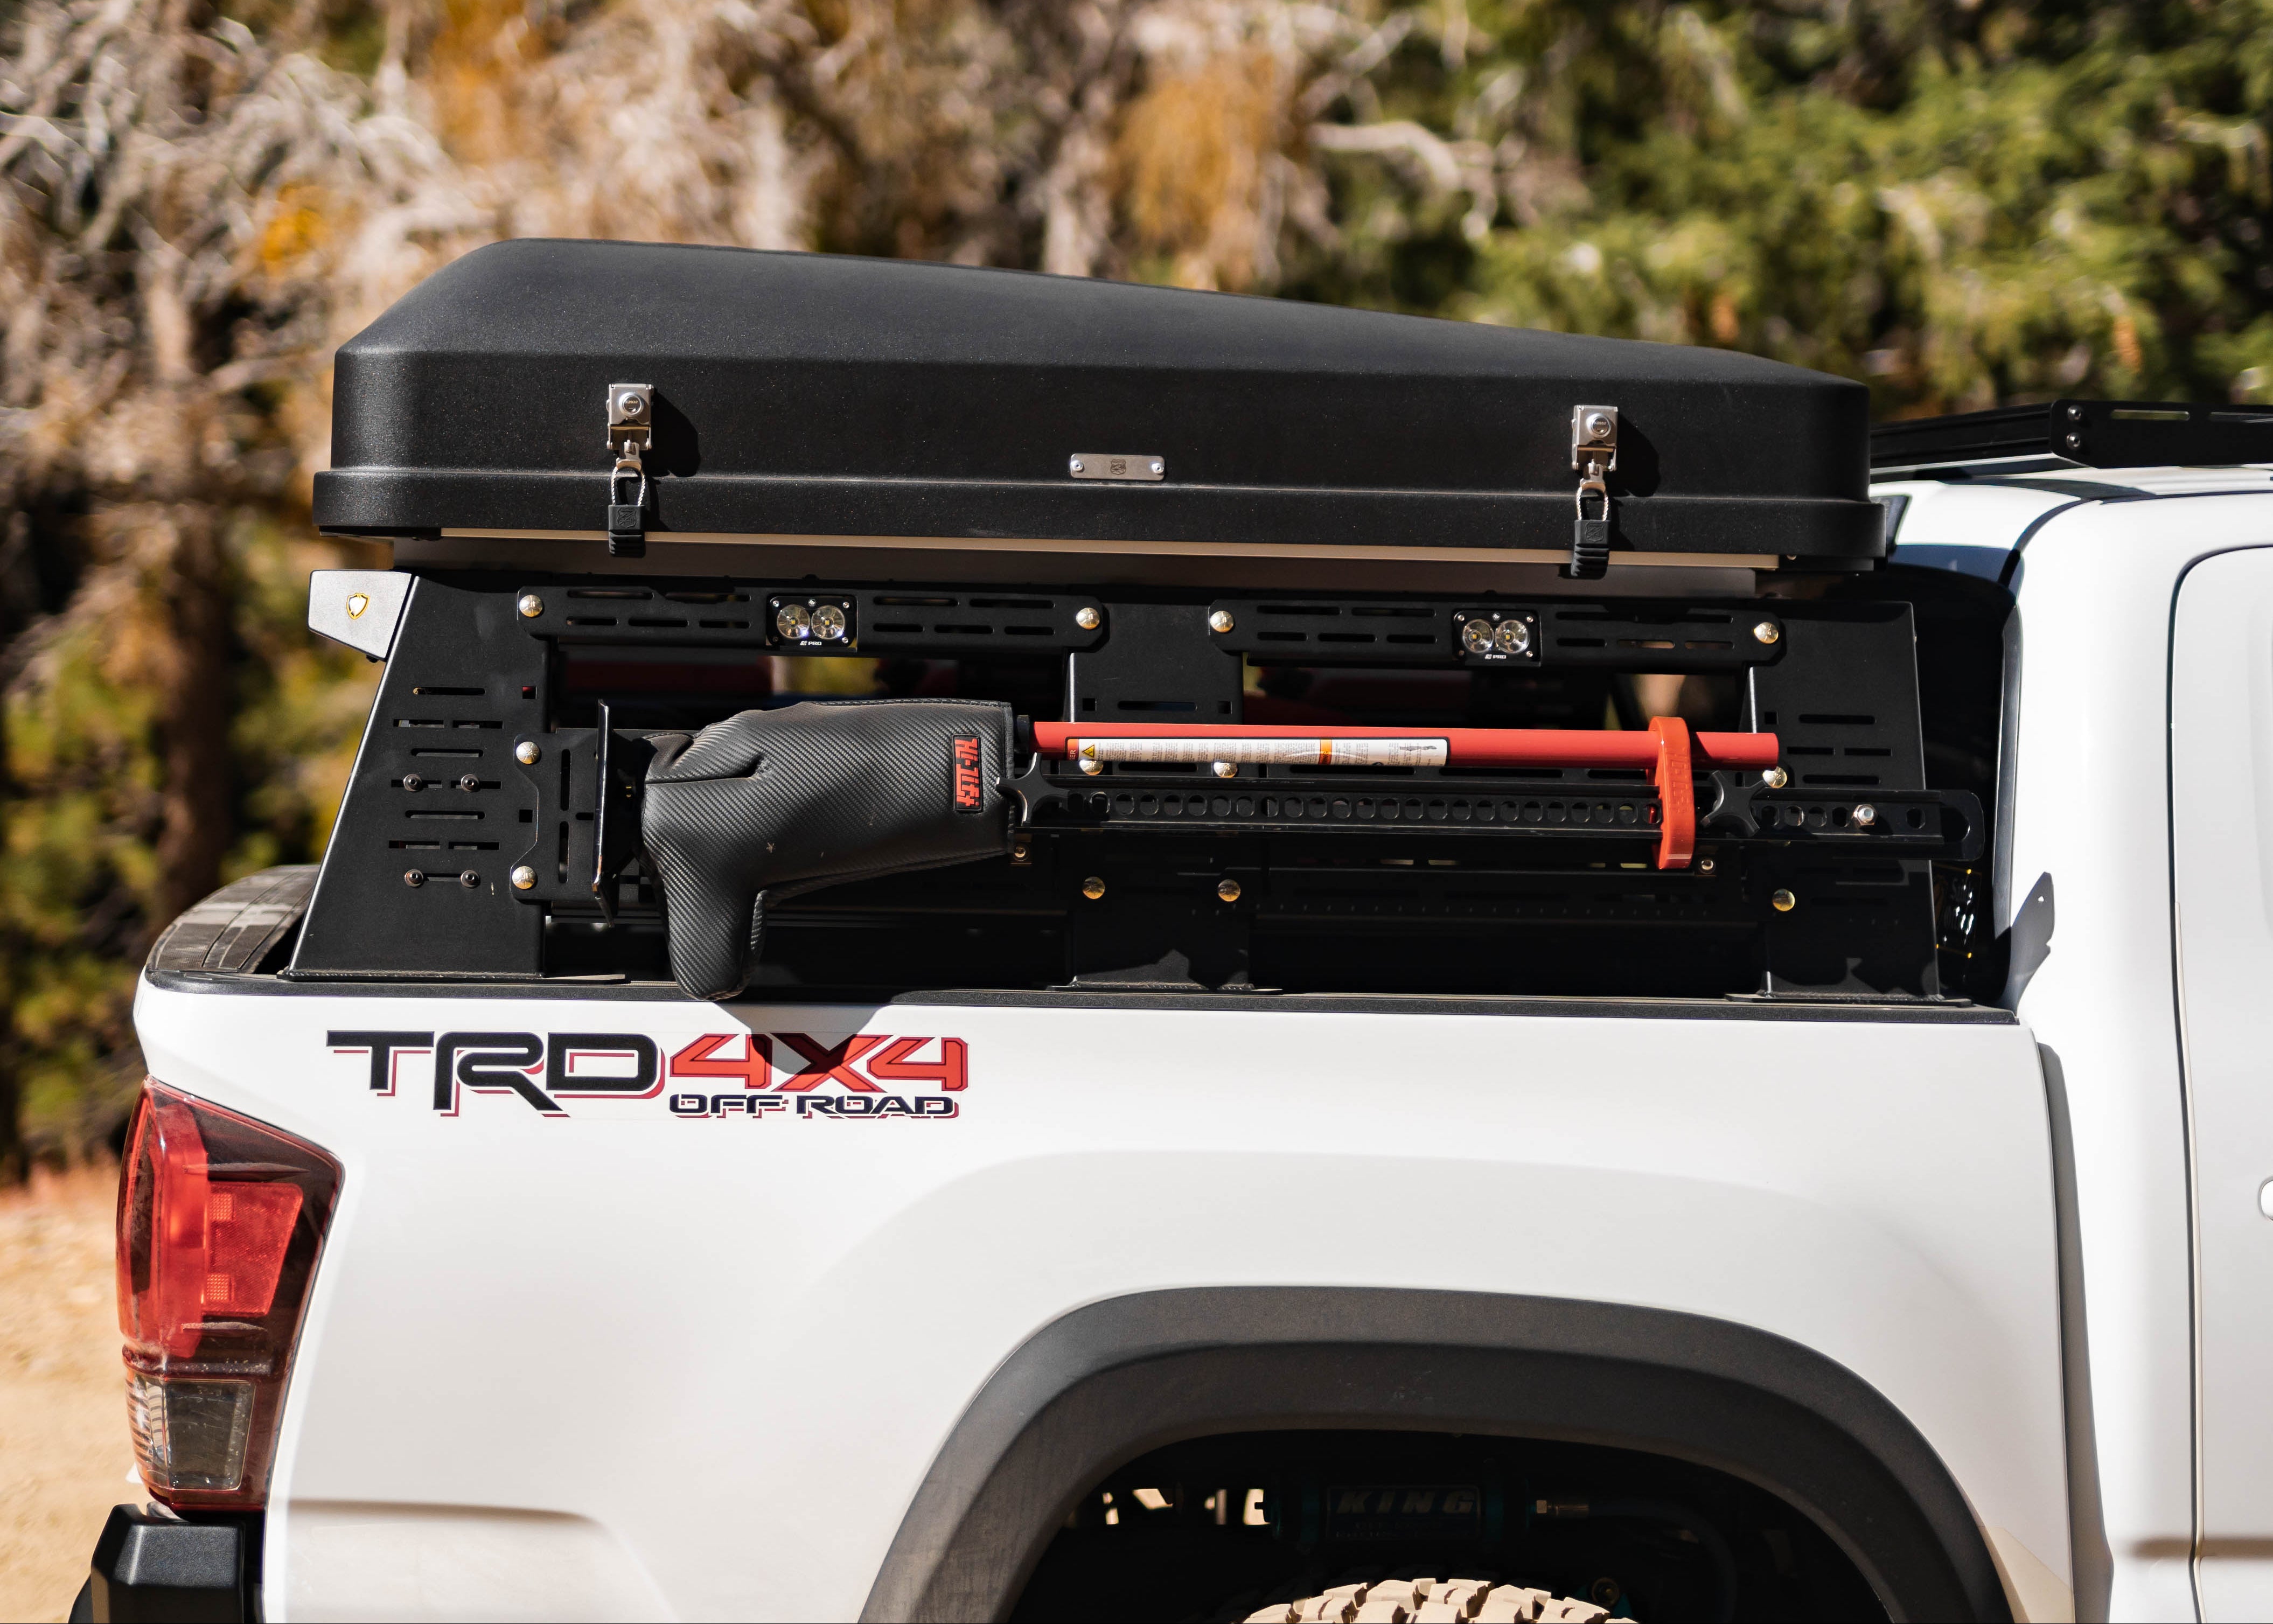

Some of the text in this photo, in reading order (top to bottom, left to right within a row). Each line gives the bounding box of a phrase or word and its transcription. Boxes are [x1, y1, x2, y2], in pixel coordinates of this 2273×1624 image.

[326, 1030, 666, 1117] TRD
[670, 1094, 959, 1119] OFF ROAD
[1336, 1490, 1474, 1514] KING
